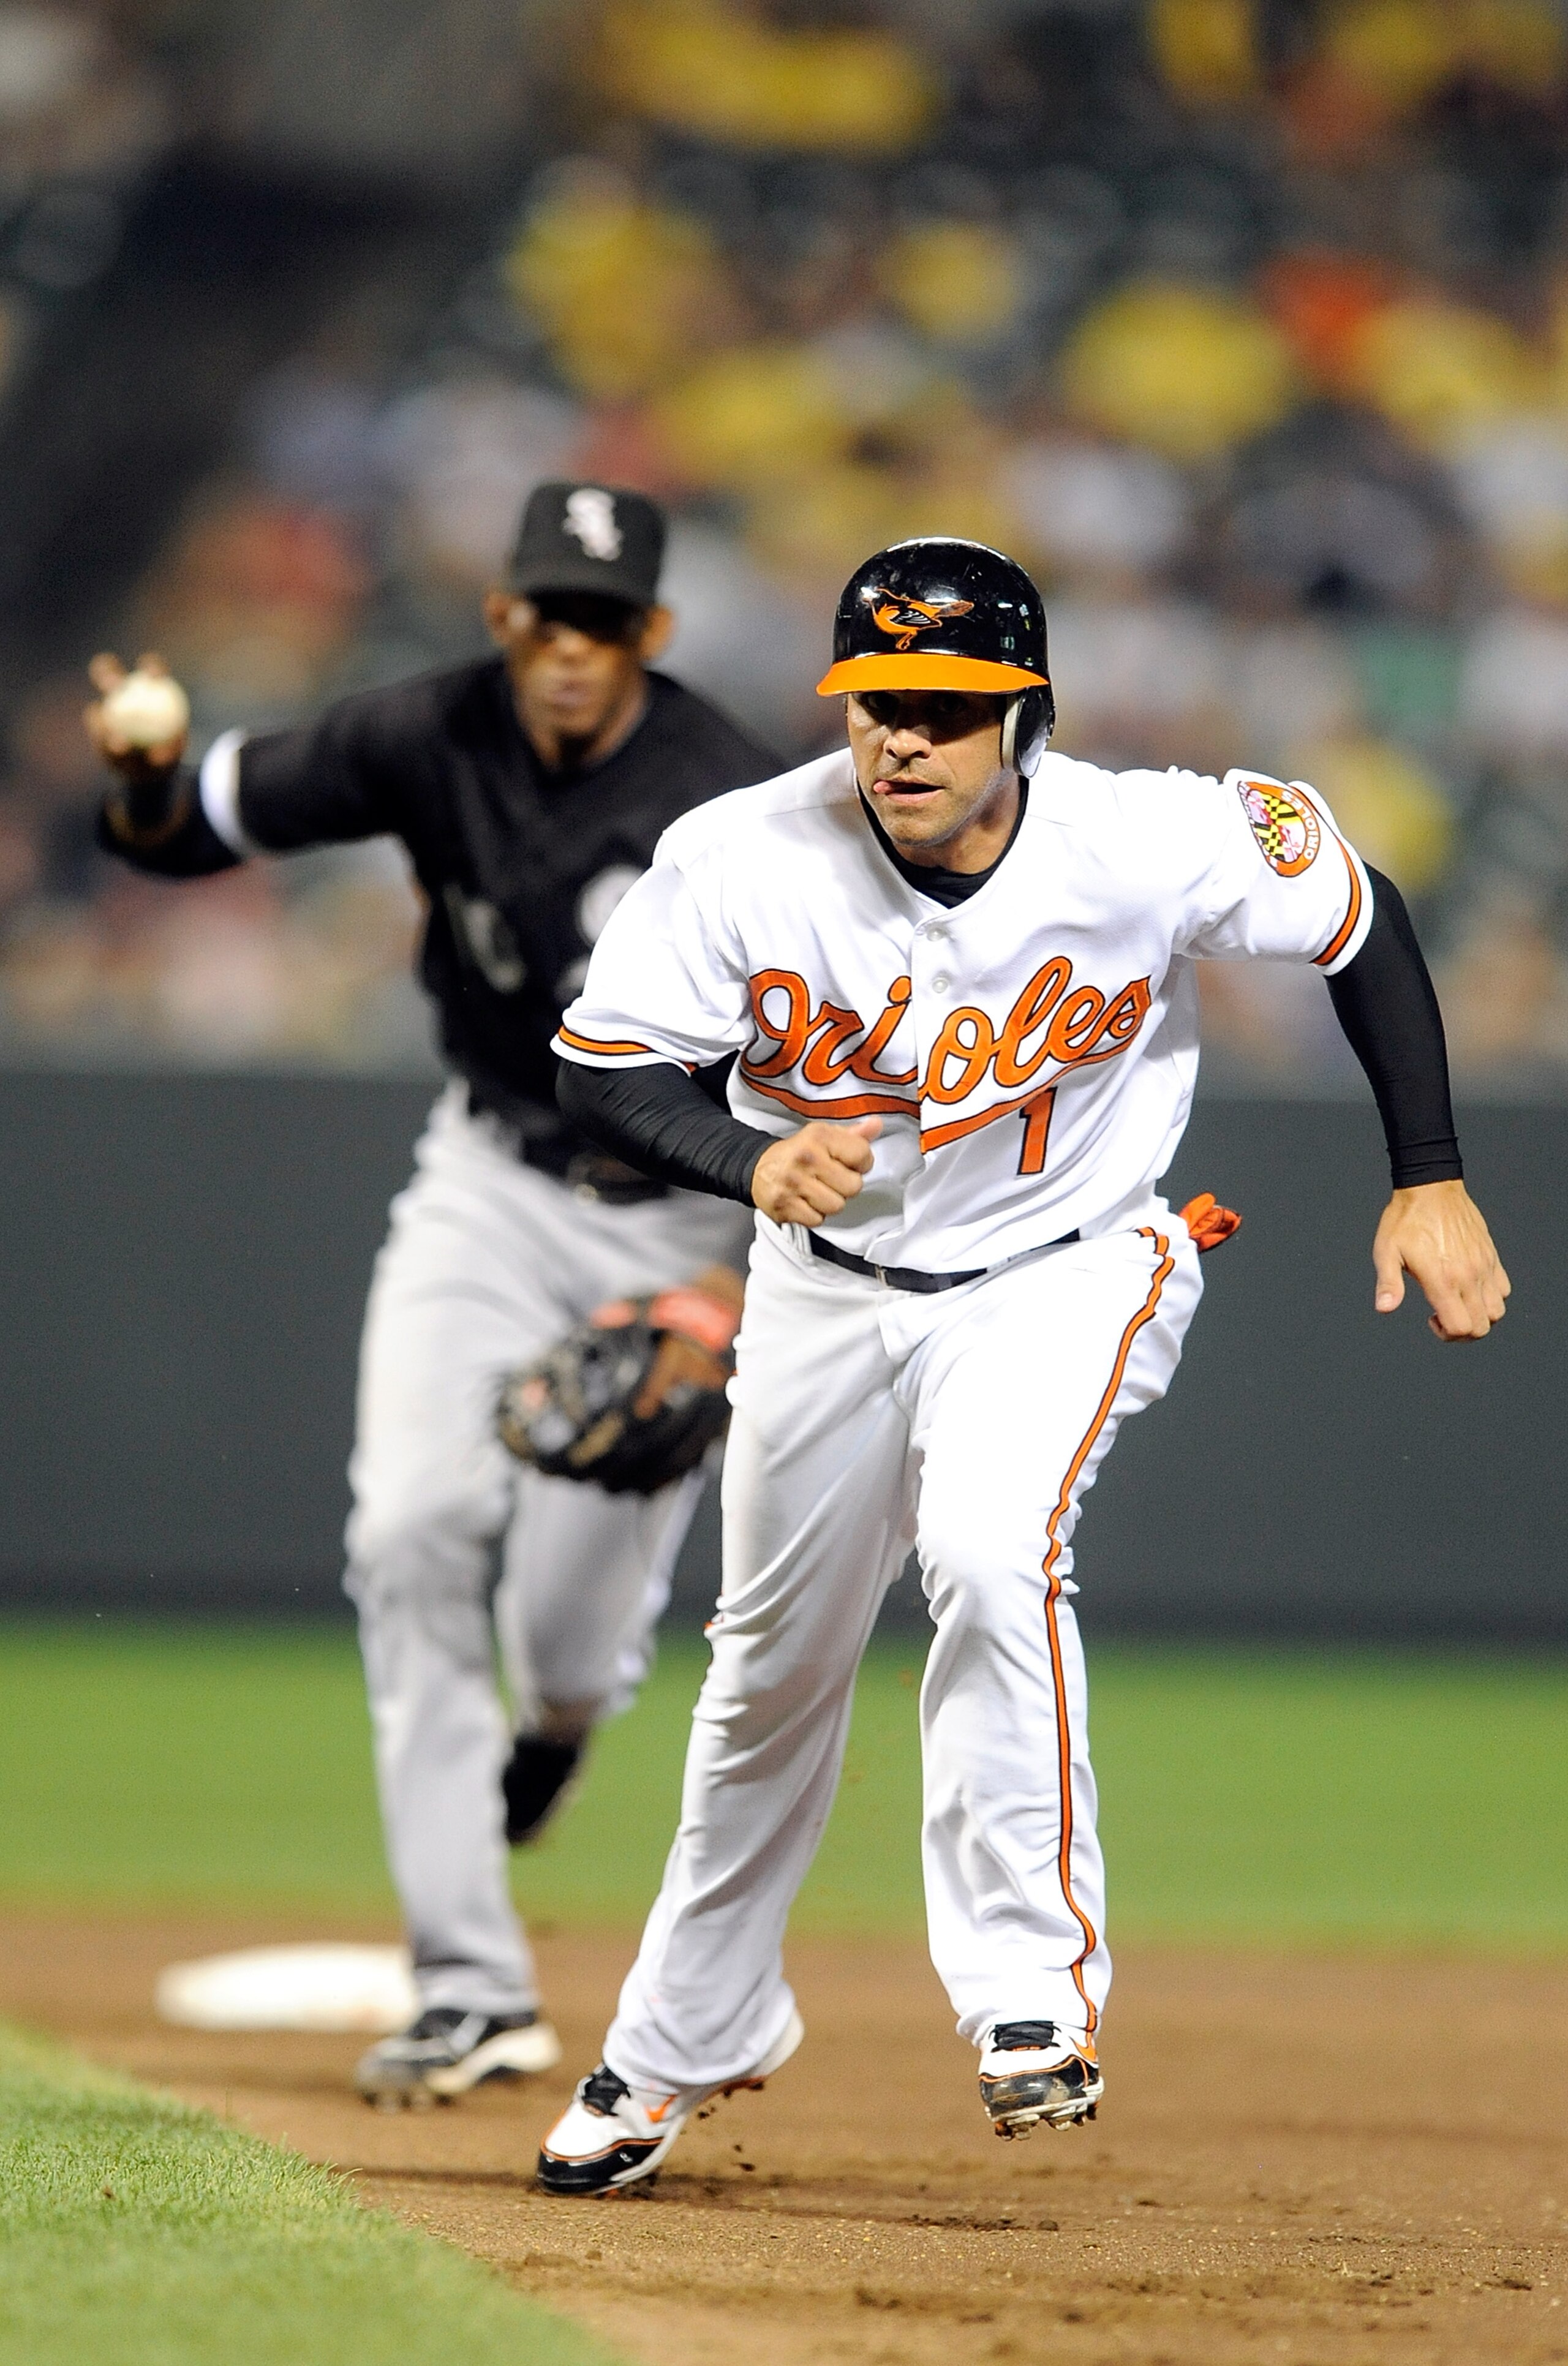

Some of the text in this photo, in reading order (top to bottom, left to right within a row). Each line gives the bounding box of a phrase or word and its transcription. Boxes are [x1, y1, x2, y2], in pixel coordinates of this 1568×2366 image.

[1281, 790, 1318, 860] ORIOLES
[740, 955, 1152, 1104] Orioles
[1017, 1087, 1057, 1175] 1
